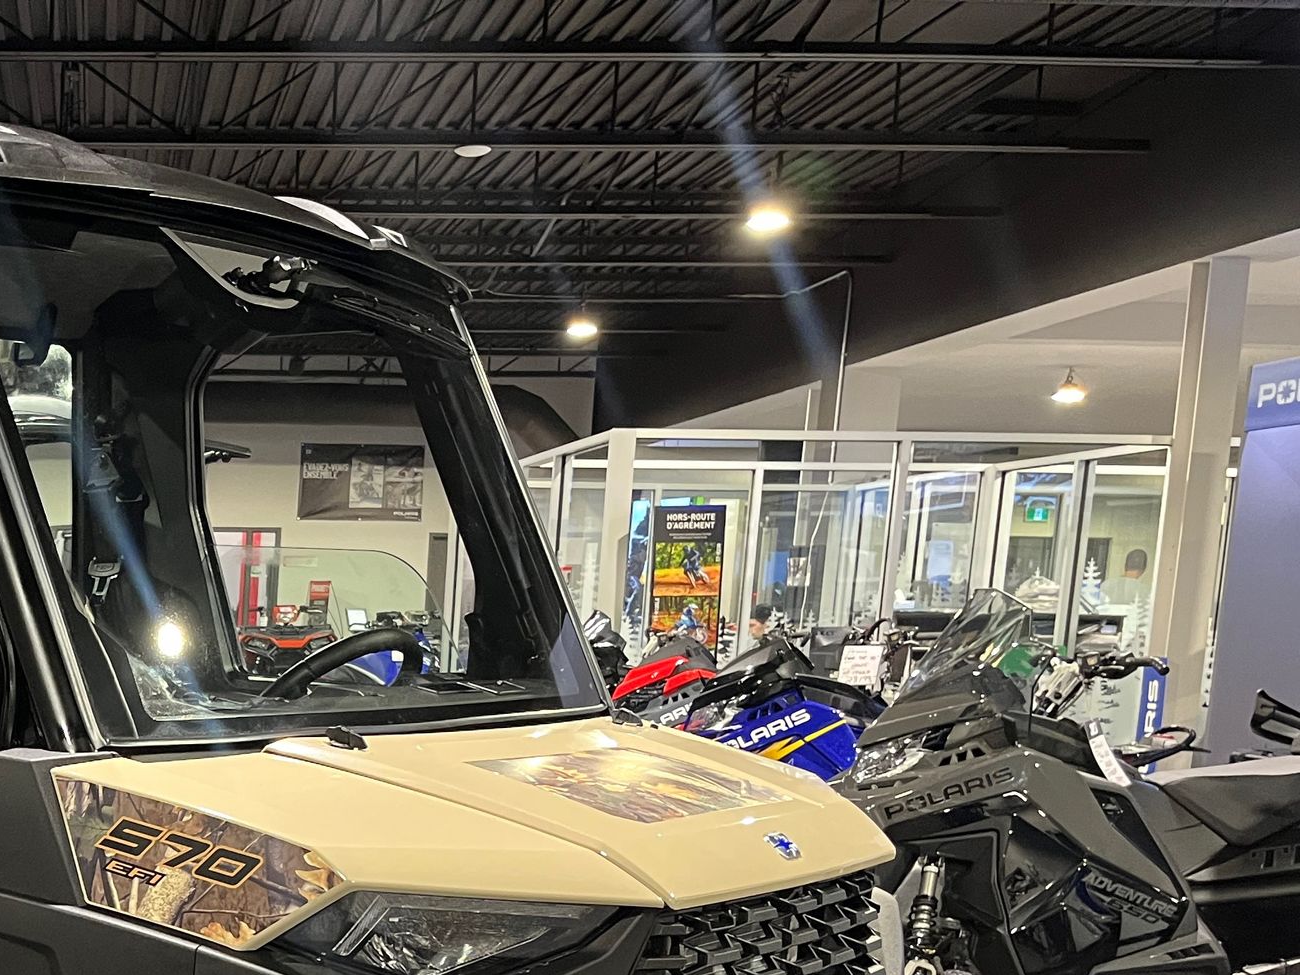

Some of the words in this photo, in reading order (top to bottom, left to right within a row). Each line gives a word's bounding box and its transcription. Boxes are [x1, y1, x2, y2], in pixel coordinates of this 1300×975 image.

[666, 513, 716, 521] HORS-ROUTE
[884, 767, 1015, 820] POLARIS
[94, 816, 263, 889] 570
[104, 858, 167, 886] EFI
[1083, 868, 1178, 918] ADVENTURE
